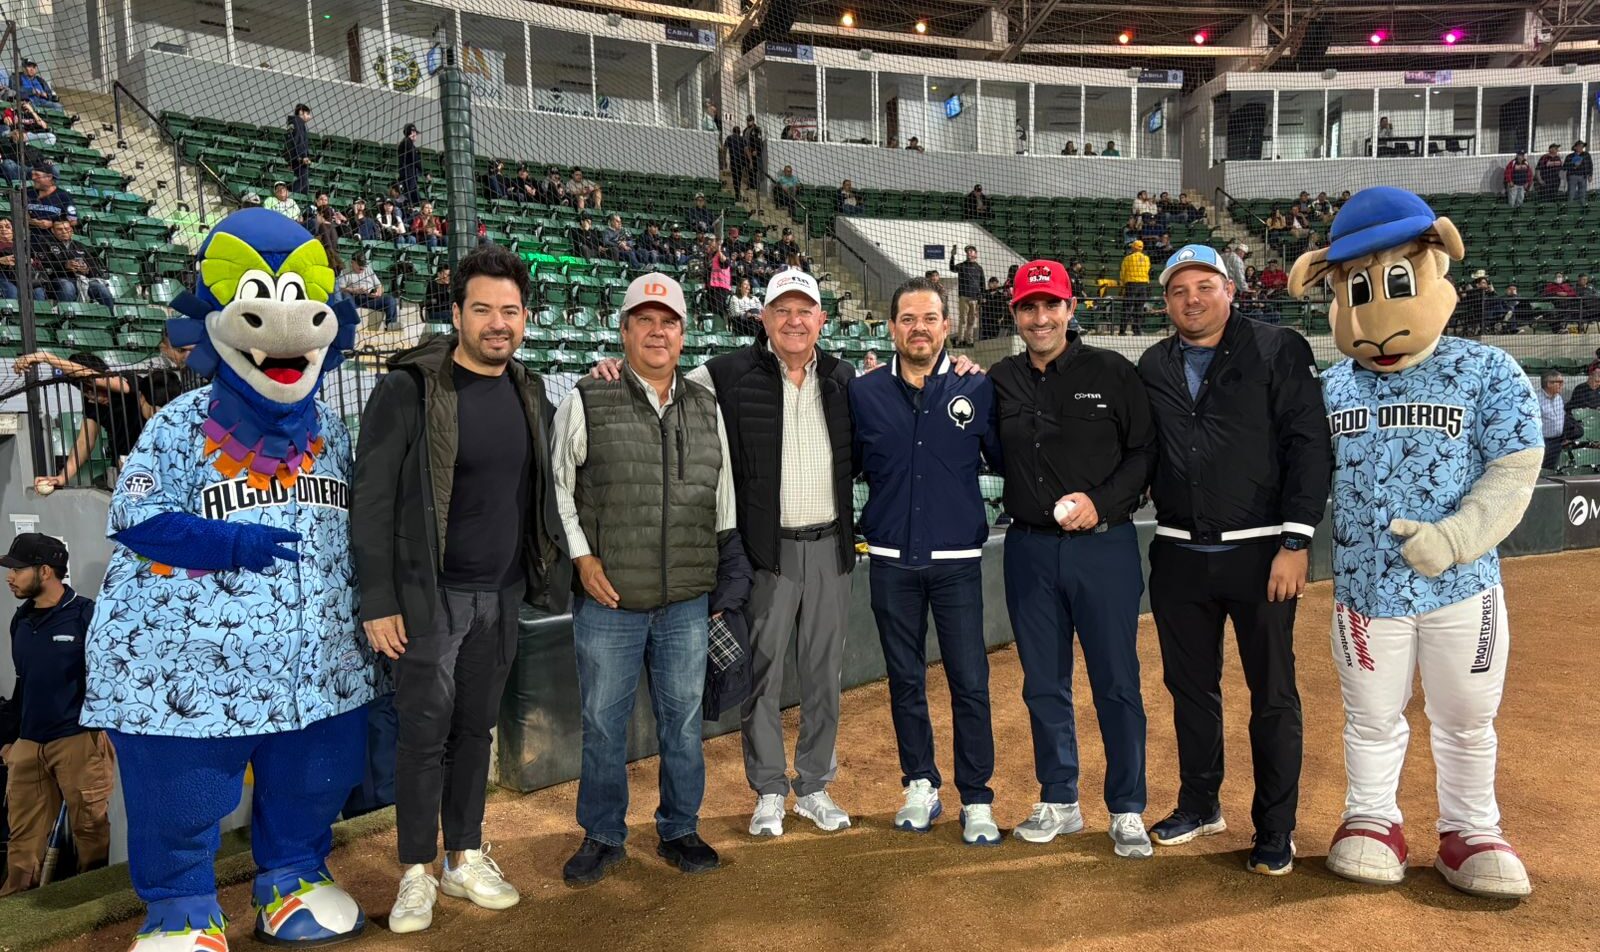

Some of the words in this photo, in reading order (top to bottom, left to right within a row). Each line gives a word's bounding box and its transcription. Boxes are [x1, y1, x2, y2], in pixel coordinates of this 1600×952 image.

[667, 29, 694, 37] CABINA
[1337, 613, 1354, 668] caliente.mx
[1474, 593, 1492, 665] PAQUETEXPRESS
